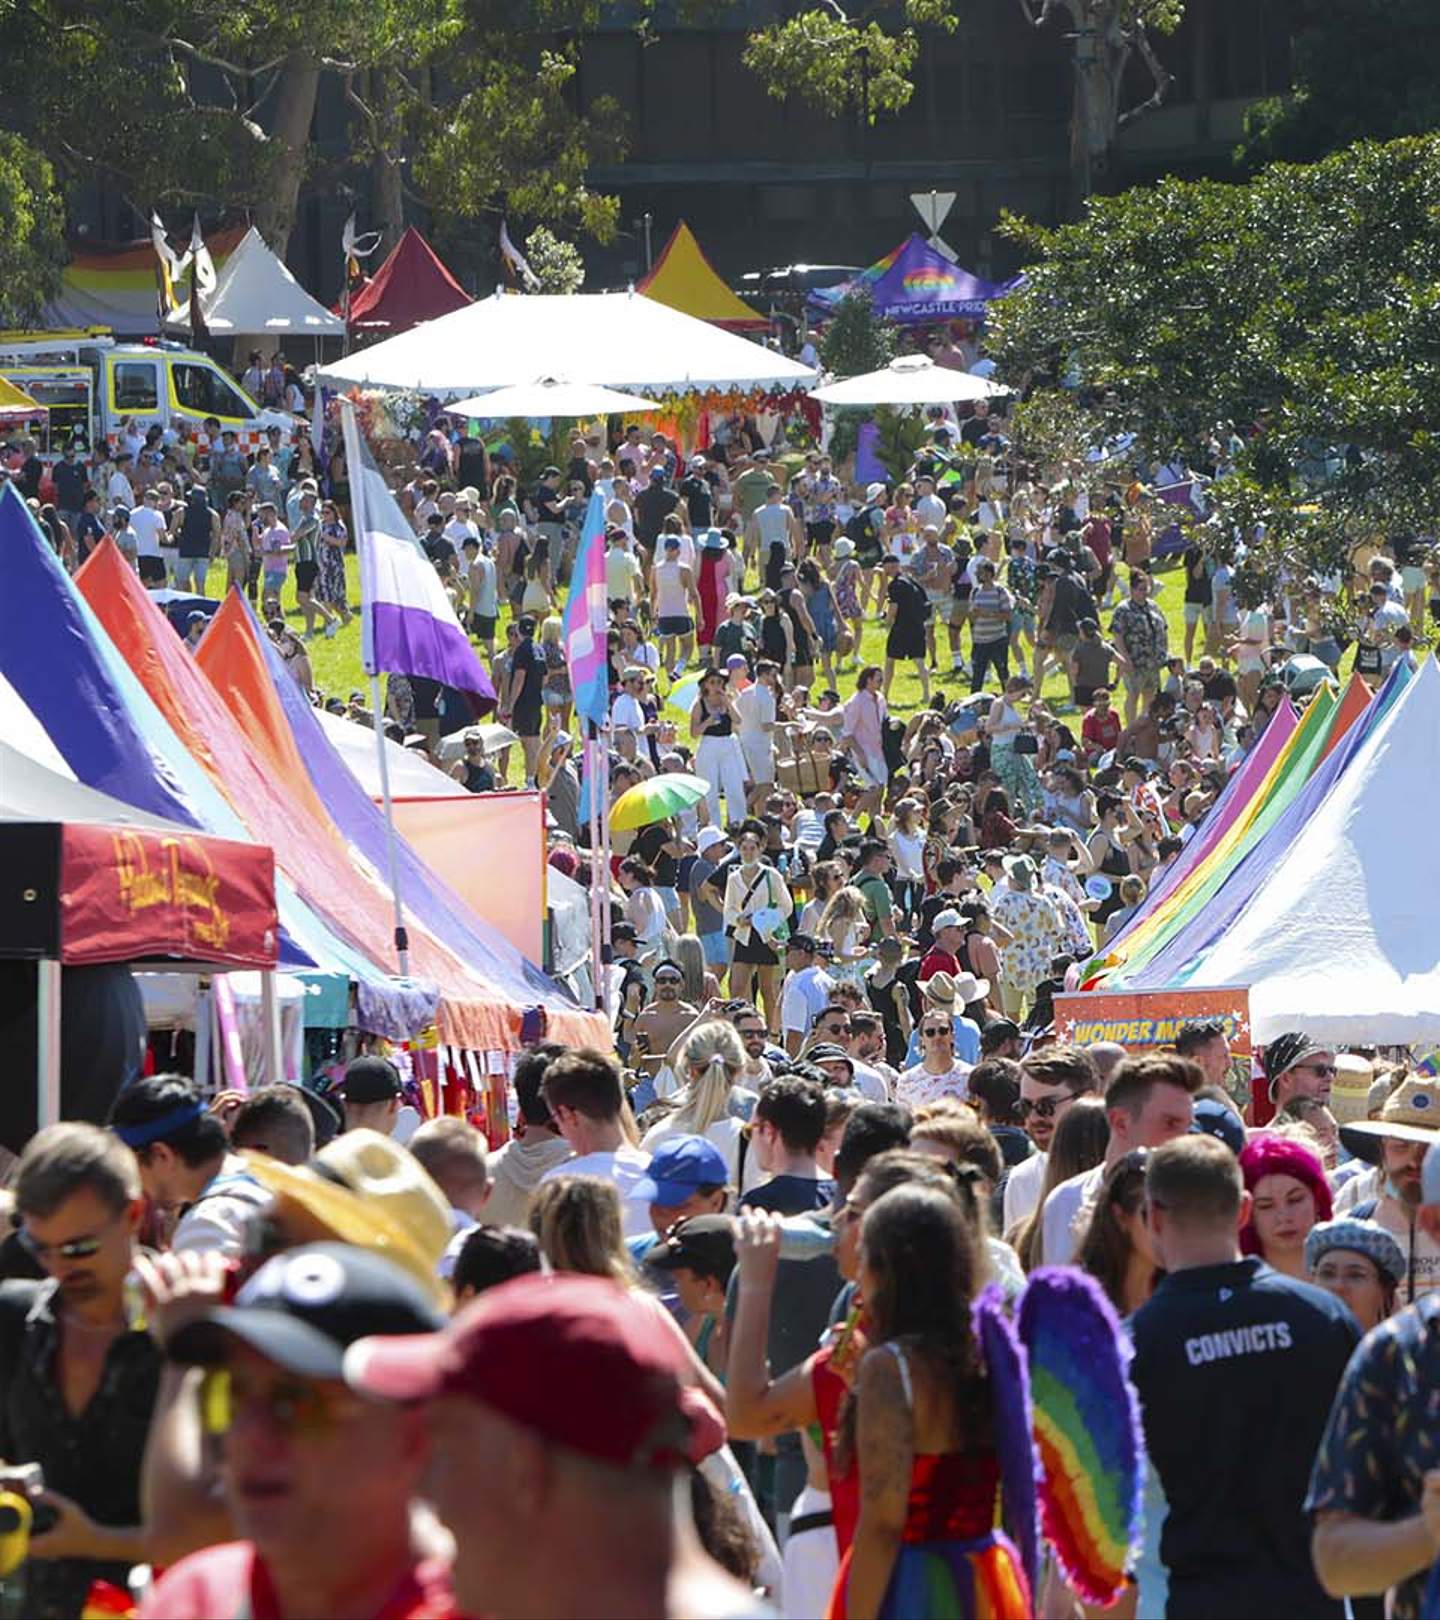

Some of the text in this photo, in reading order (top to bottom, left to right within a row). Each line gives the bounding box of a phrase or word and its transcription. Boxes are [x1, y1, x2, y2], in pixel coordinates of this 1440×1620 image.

[885, 301, 957, 315] NEWCASTLE
[1074, 1020, 1153, 1044] WONDER
[1185, 1321, 1293, 1366] CONVICTS
